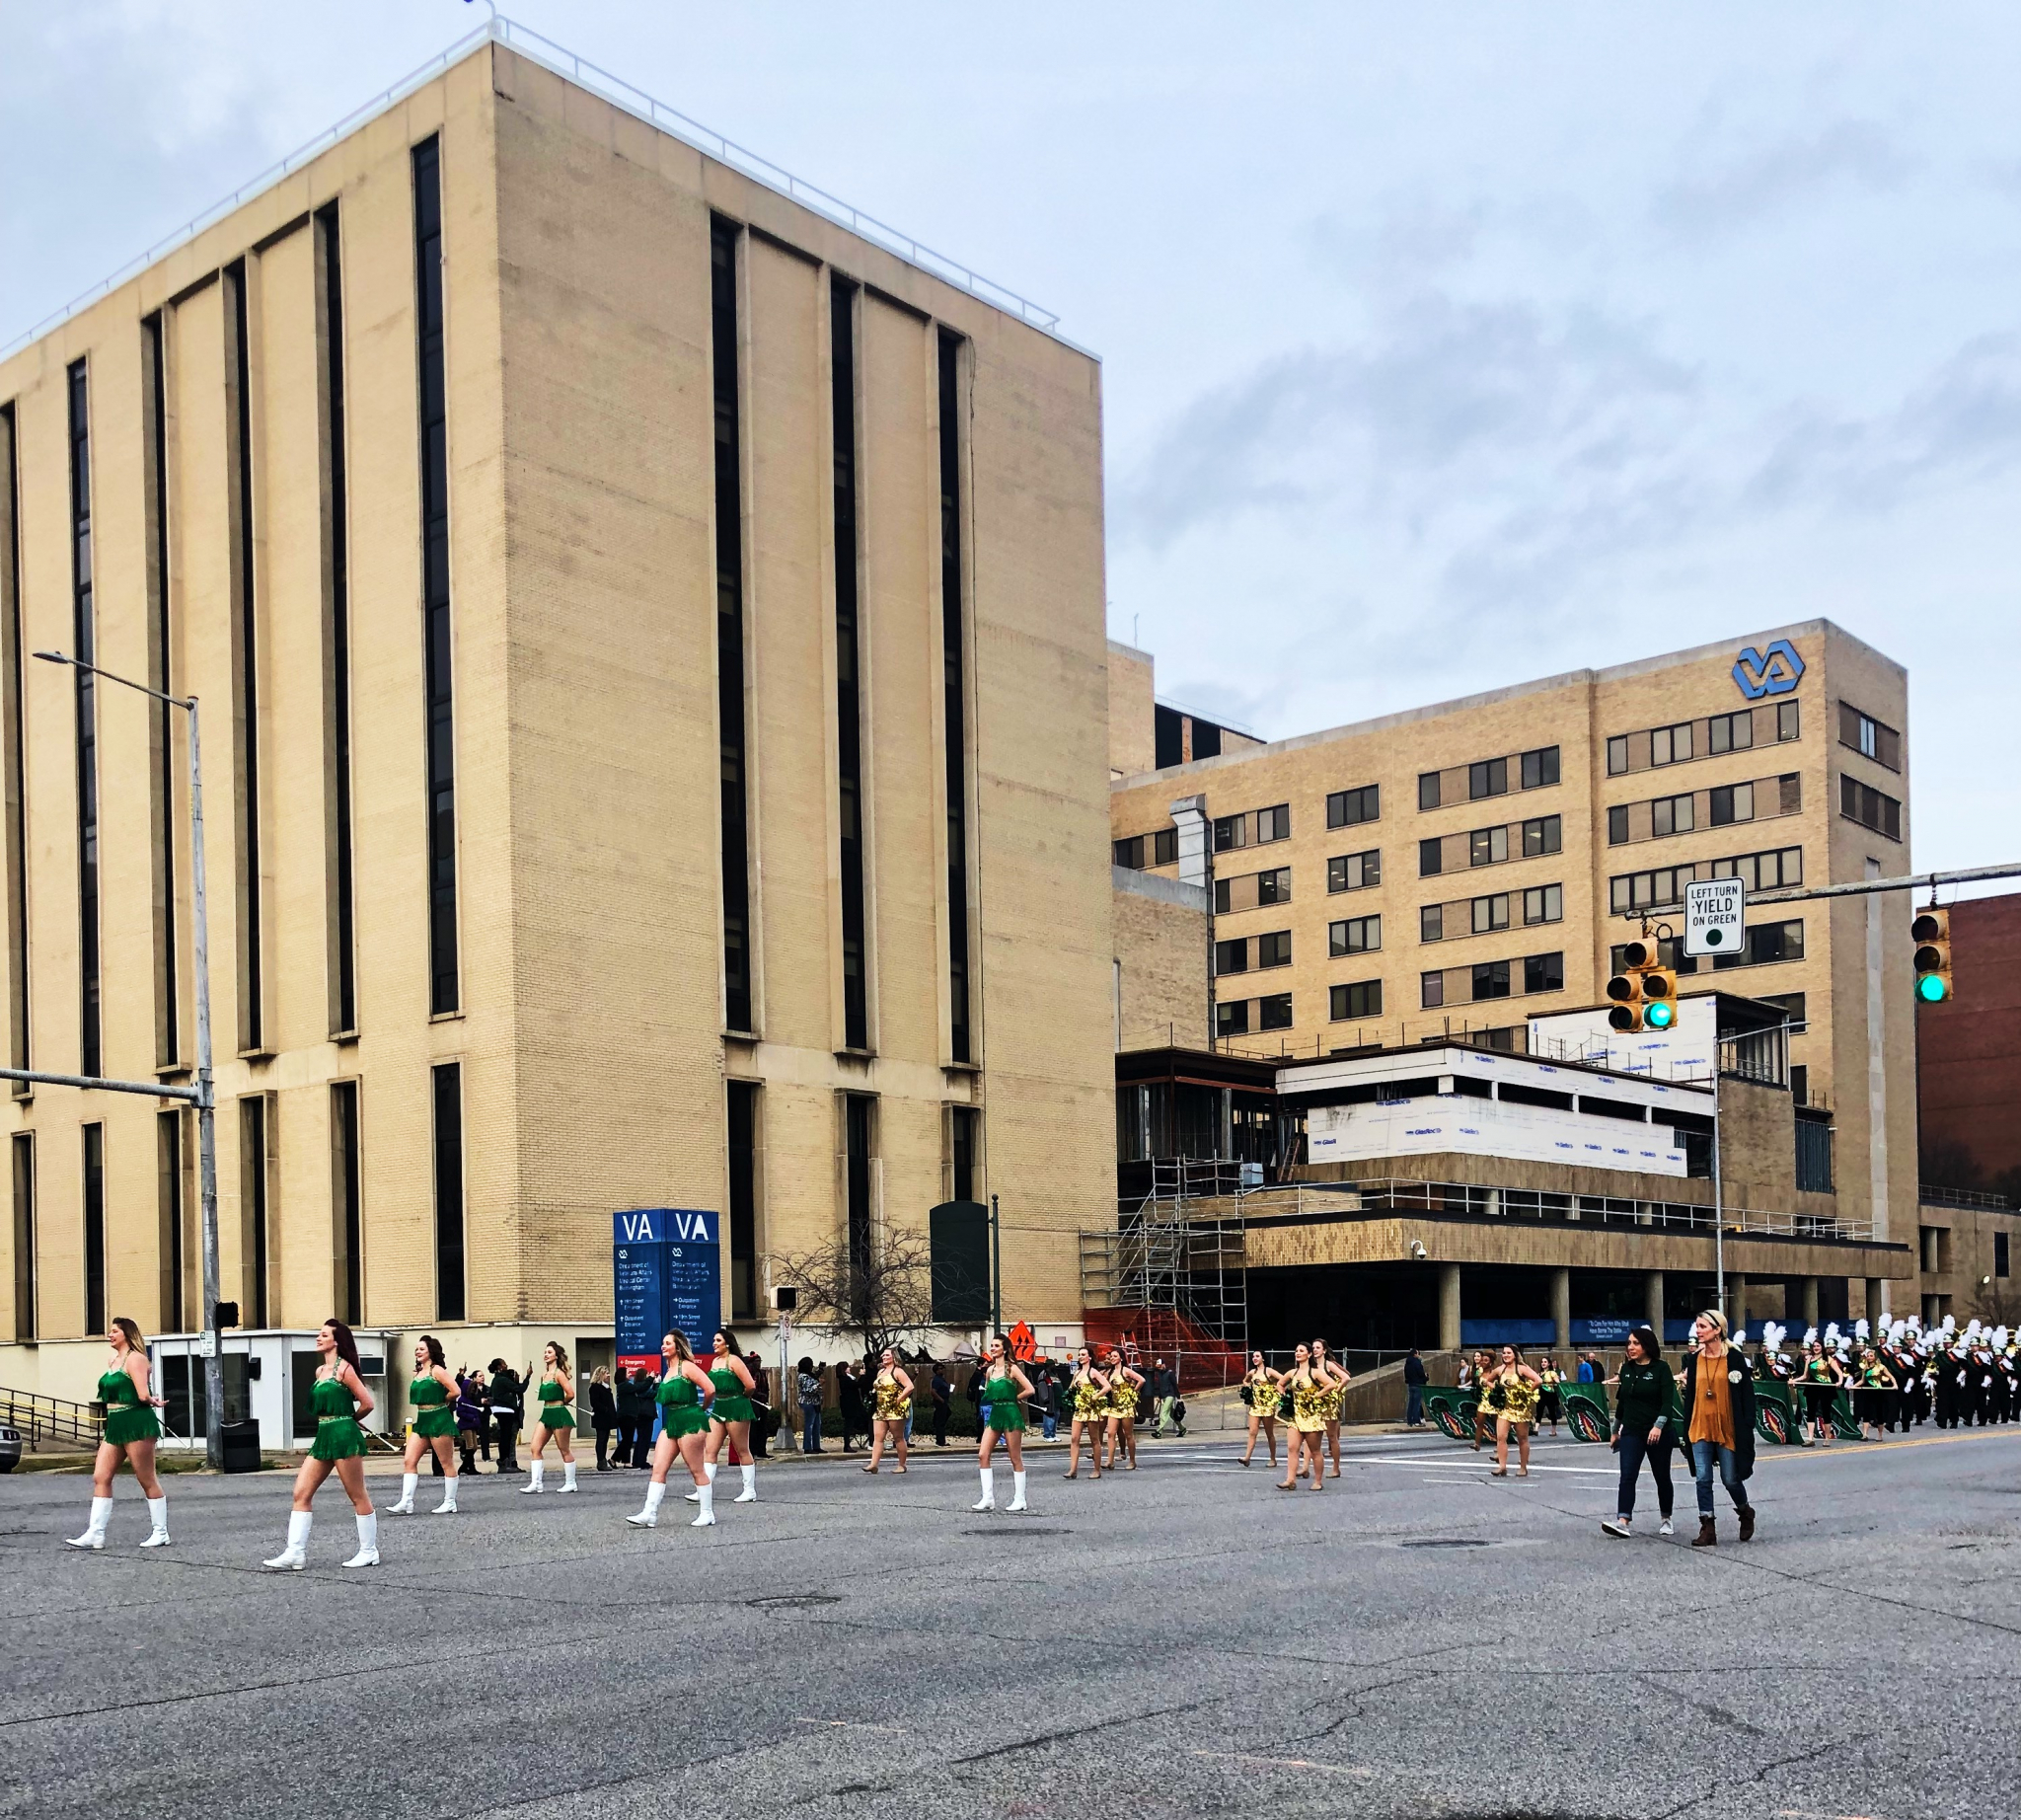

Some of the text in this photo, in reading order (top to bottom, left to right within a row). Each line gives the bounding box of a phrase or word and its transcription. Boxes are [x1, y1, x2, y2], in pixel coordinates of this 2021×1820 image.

[1691, 885, 1738, 899] LEFT TURN
[1695, 898, 1733, 914] YIELD
[1692, 913, 1737, 926] ON GREEN
[622, 1214, 653, 1241] VA
[675, 1213, 709, 1241] VA
